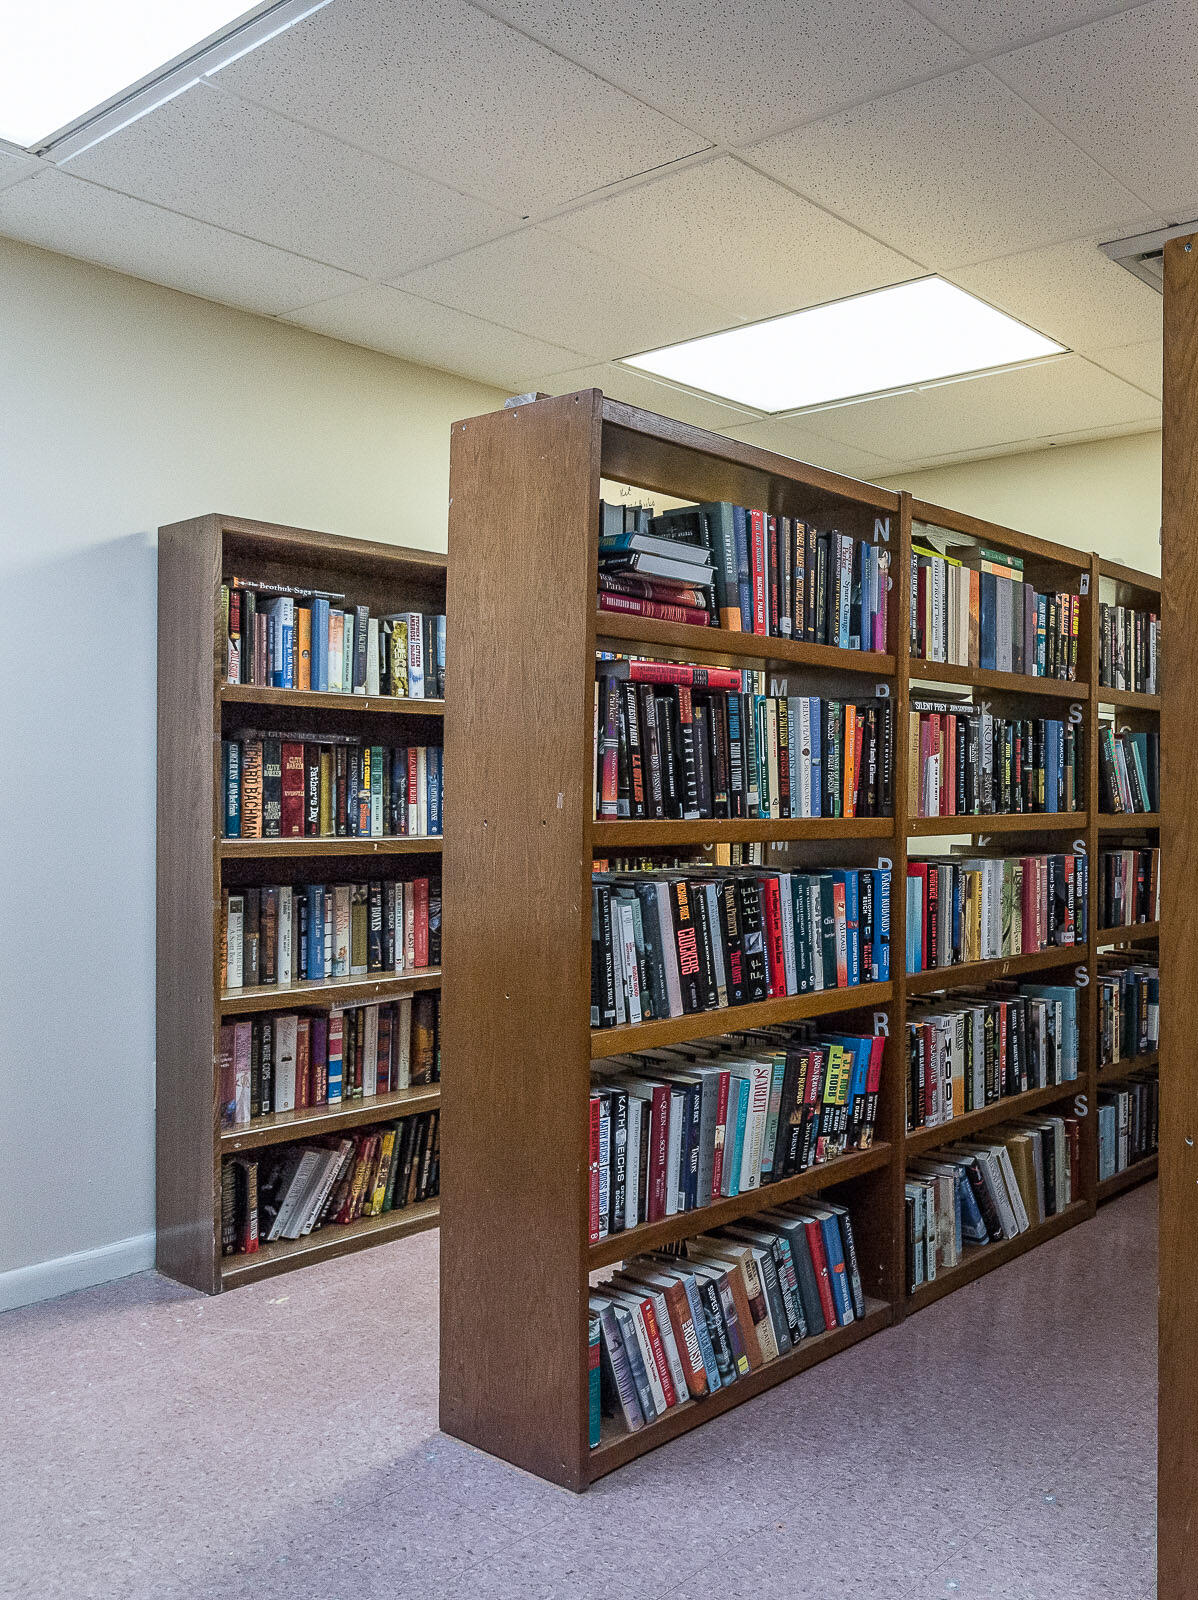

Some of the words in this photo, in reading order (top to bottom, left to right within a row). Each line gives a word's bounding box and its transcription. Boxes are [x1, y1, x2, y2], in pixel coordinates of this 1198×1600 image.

[796, 523, 805, 546] MICHAEL
[874, 517, 890, 542] N
[796, 547, 805, 567] PALMER
[795, 578, 804, 601] CRITICAL
[842, 580, 851, 602] Spare
[795, 602, 804, 630] JUDGMENT
[840, 603, 849, 633] Change
[626, 693, 637, 724] JEFFERSON
[779, 700, 787, 716] JAMES
[802, 701, 810, 722] BELVA
[915, 701, 933, 711] SILENT
[934, 702, 947, 712] PREY
[1068, 703, 1083, 724] S
[630, 725, 639, 746] PARKER
[779, 717, 788, 747] PATTERSON
[802, 725, 810, 748] PLAIN
[683, 728, 695, 762] DARK
[984, 724, 992, 766] ROMA
[632, 754, 641, 767] L.A.
[780, 750, 789, 776] CROSS
[310, 766, 319, 805] Father's
[633, 768, 644, 802] OUTLAWS
[686, 771, 697, 805] LADY
[781, 777, 790, 797] FIRE
[803, 758, 811, 807] CROSSROADS
[244, 787, 258, 839] BACHMAN
[308, 806, 318, 822] Day
[676, 882, 688, 905] RICHARD
[881, 872, 890, 896] KAREN
[602, 891, 610, 912] CLEAR
[725, 885, 736, 908] FRANK
[679, 906, 690, 920] PRICE
[727, 908, 738, 936] PERETTI
[880, 899, 890, 932] ROBARDS
[603, 913, 611, 946] PICTURES
[677, 927, 700, 976] CLOCKERS
[730, 950, 741, 966] THE
[731, 966, 742, 985] OATH
[1074, 966, 1089, 988] S
[873, 1012, 889, 1037] R
[812, 1055, 822, 1075] KAREN
[752, 1068, 769, 1113] SCARLETT
[809, 1075, 820, 1101] ROBARDS
[828, 1074, 839, 1098] ROBB
[1074, 1094, 1088, 1117] S
[599, 1119, 608, 1139] KATHY
[599, 1141, 608, 1163] REICHS
[801, 1123, 813, 1162] SHATTERED
[599, 1168, 608, 1190] CROSS
[599, 1192, 608, 1213] BONES
[707, 1285, 718, 1312] SUSPECT
[683, 1327, 703, 1373] ROBINSON
